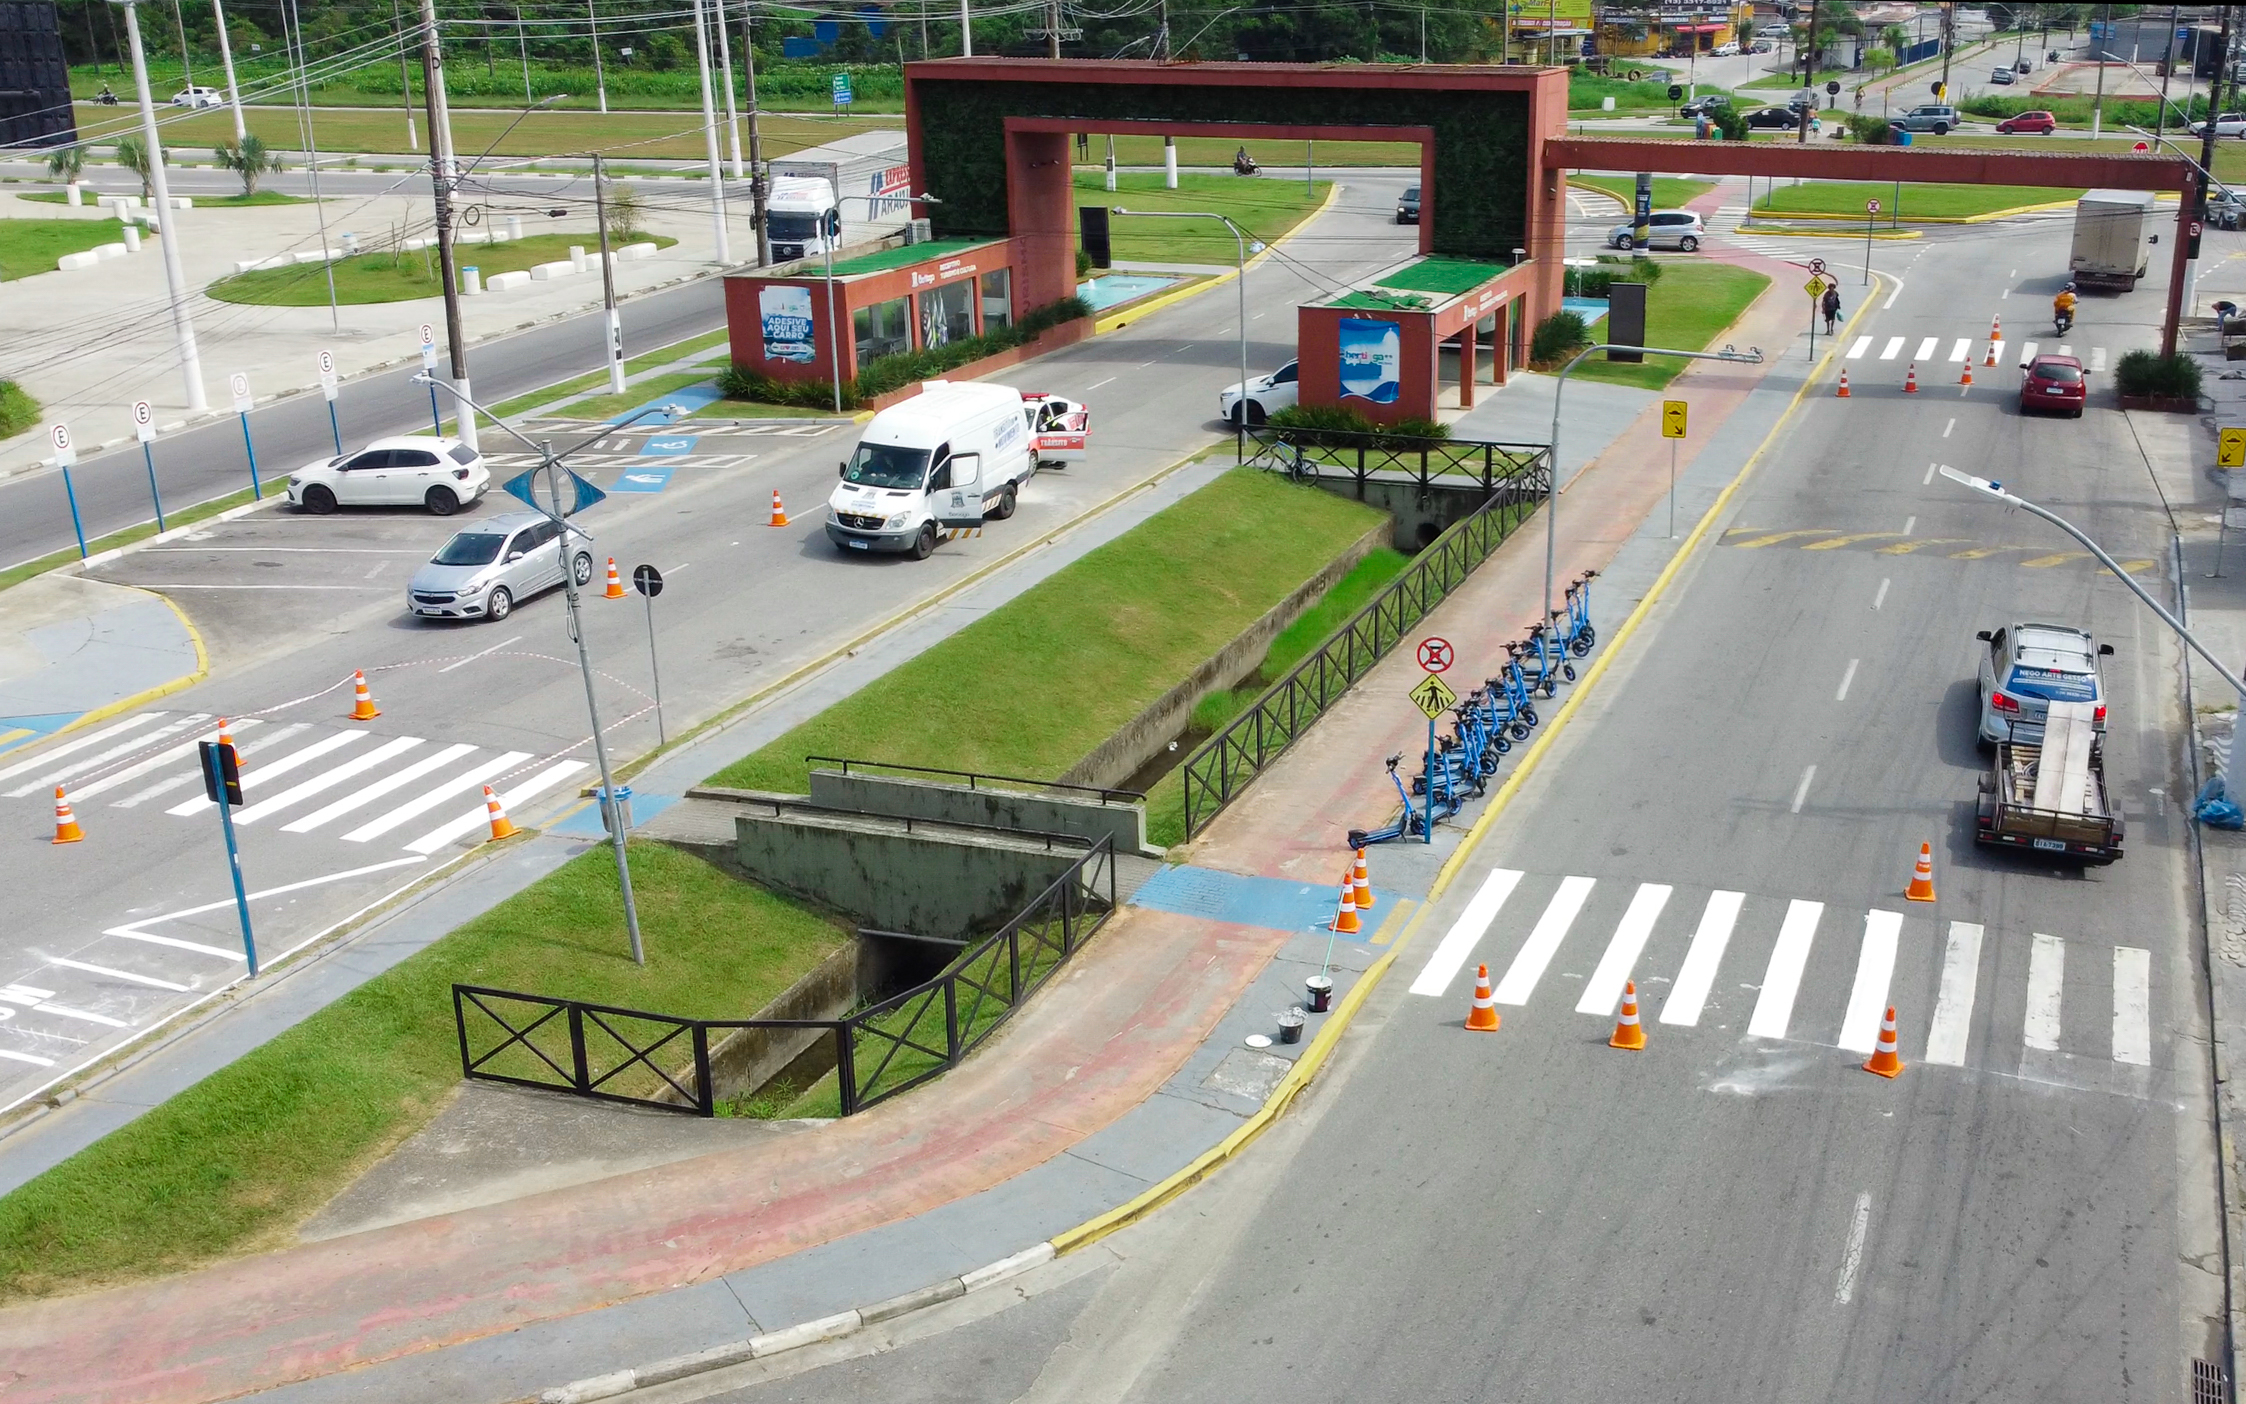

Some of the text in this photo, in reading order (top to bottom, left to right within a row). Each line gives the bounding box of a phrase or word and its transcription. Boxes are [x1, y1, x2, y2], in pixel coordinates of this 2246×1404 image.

[768, 317, 807, 326] ADESIVE
[767, 324, 809, 333] AQUI SEU
[773, 331, 805, 339] CARRO
[2020, 669, 2087, 683] NEGO ARTE GESSO
